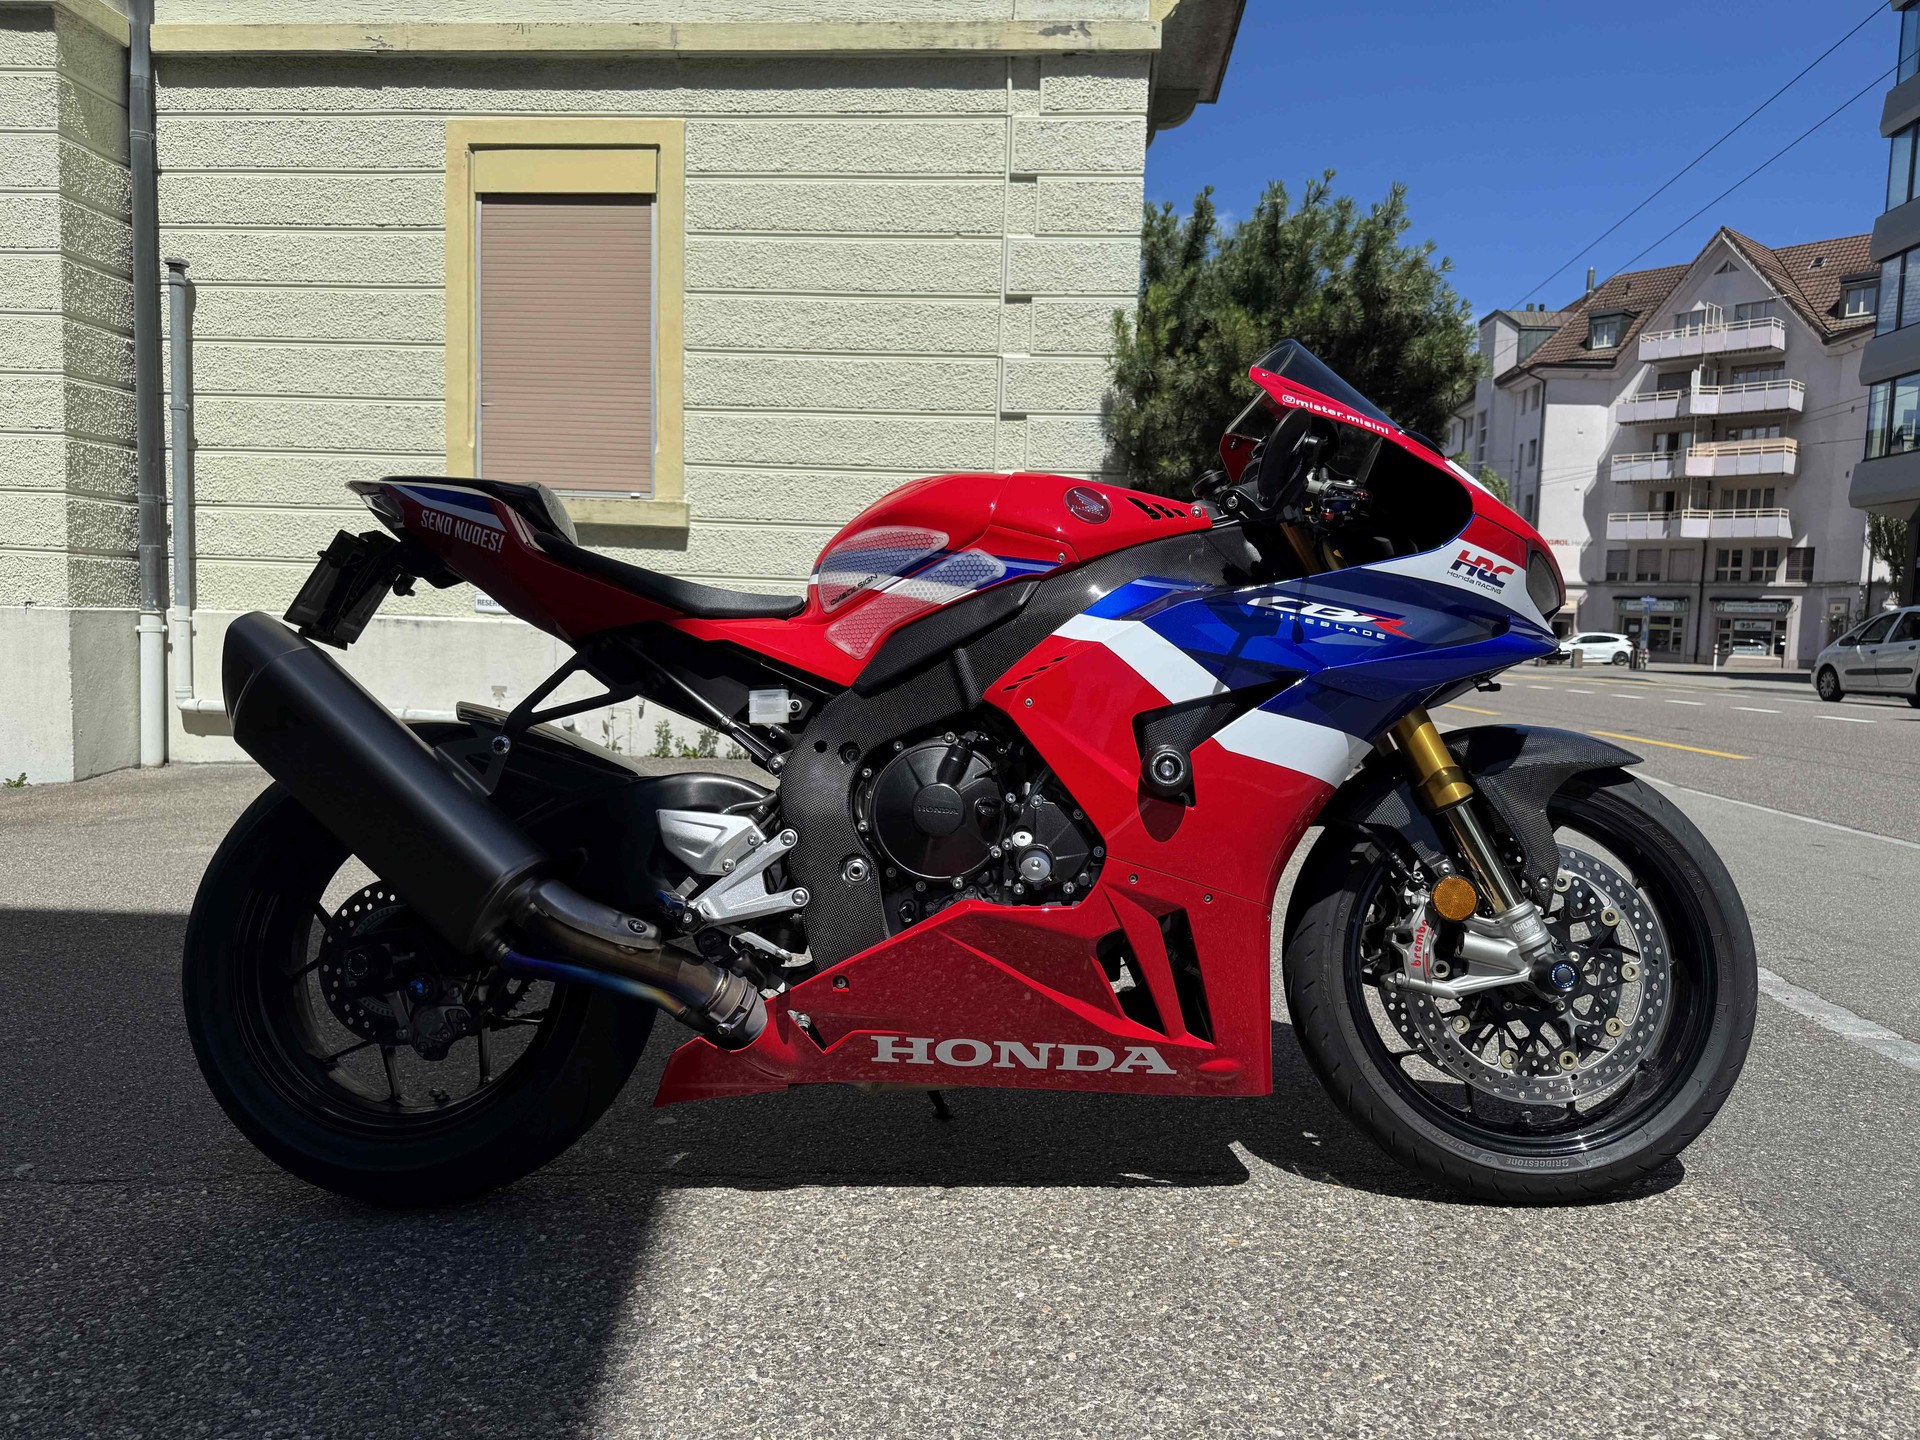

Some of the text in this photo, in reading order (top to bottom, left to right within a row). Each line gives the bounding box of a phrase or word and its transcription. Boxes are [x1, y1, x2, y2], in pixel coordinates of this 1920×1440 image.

[420, 509, 505, 553] SEND NUDES!
[1446, 569, 1502, 595] Honda RACING
[1450, 549, 1515, 588] HRC
[1264, 610, 1387, 640] FIREBLADE
[917, 805, 959, 815] HONDA
[1409, 919, 1429, 968] brembo
[870, 1035, 1177, 1075] HONDA
[1506, 1157, 1569, 1168] BRIDGESTONE
